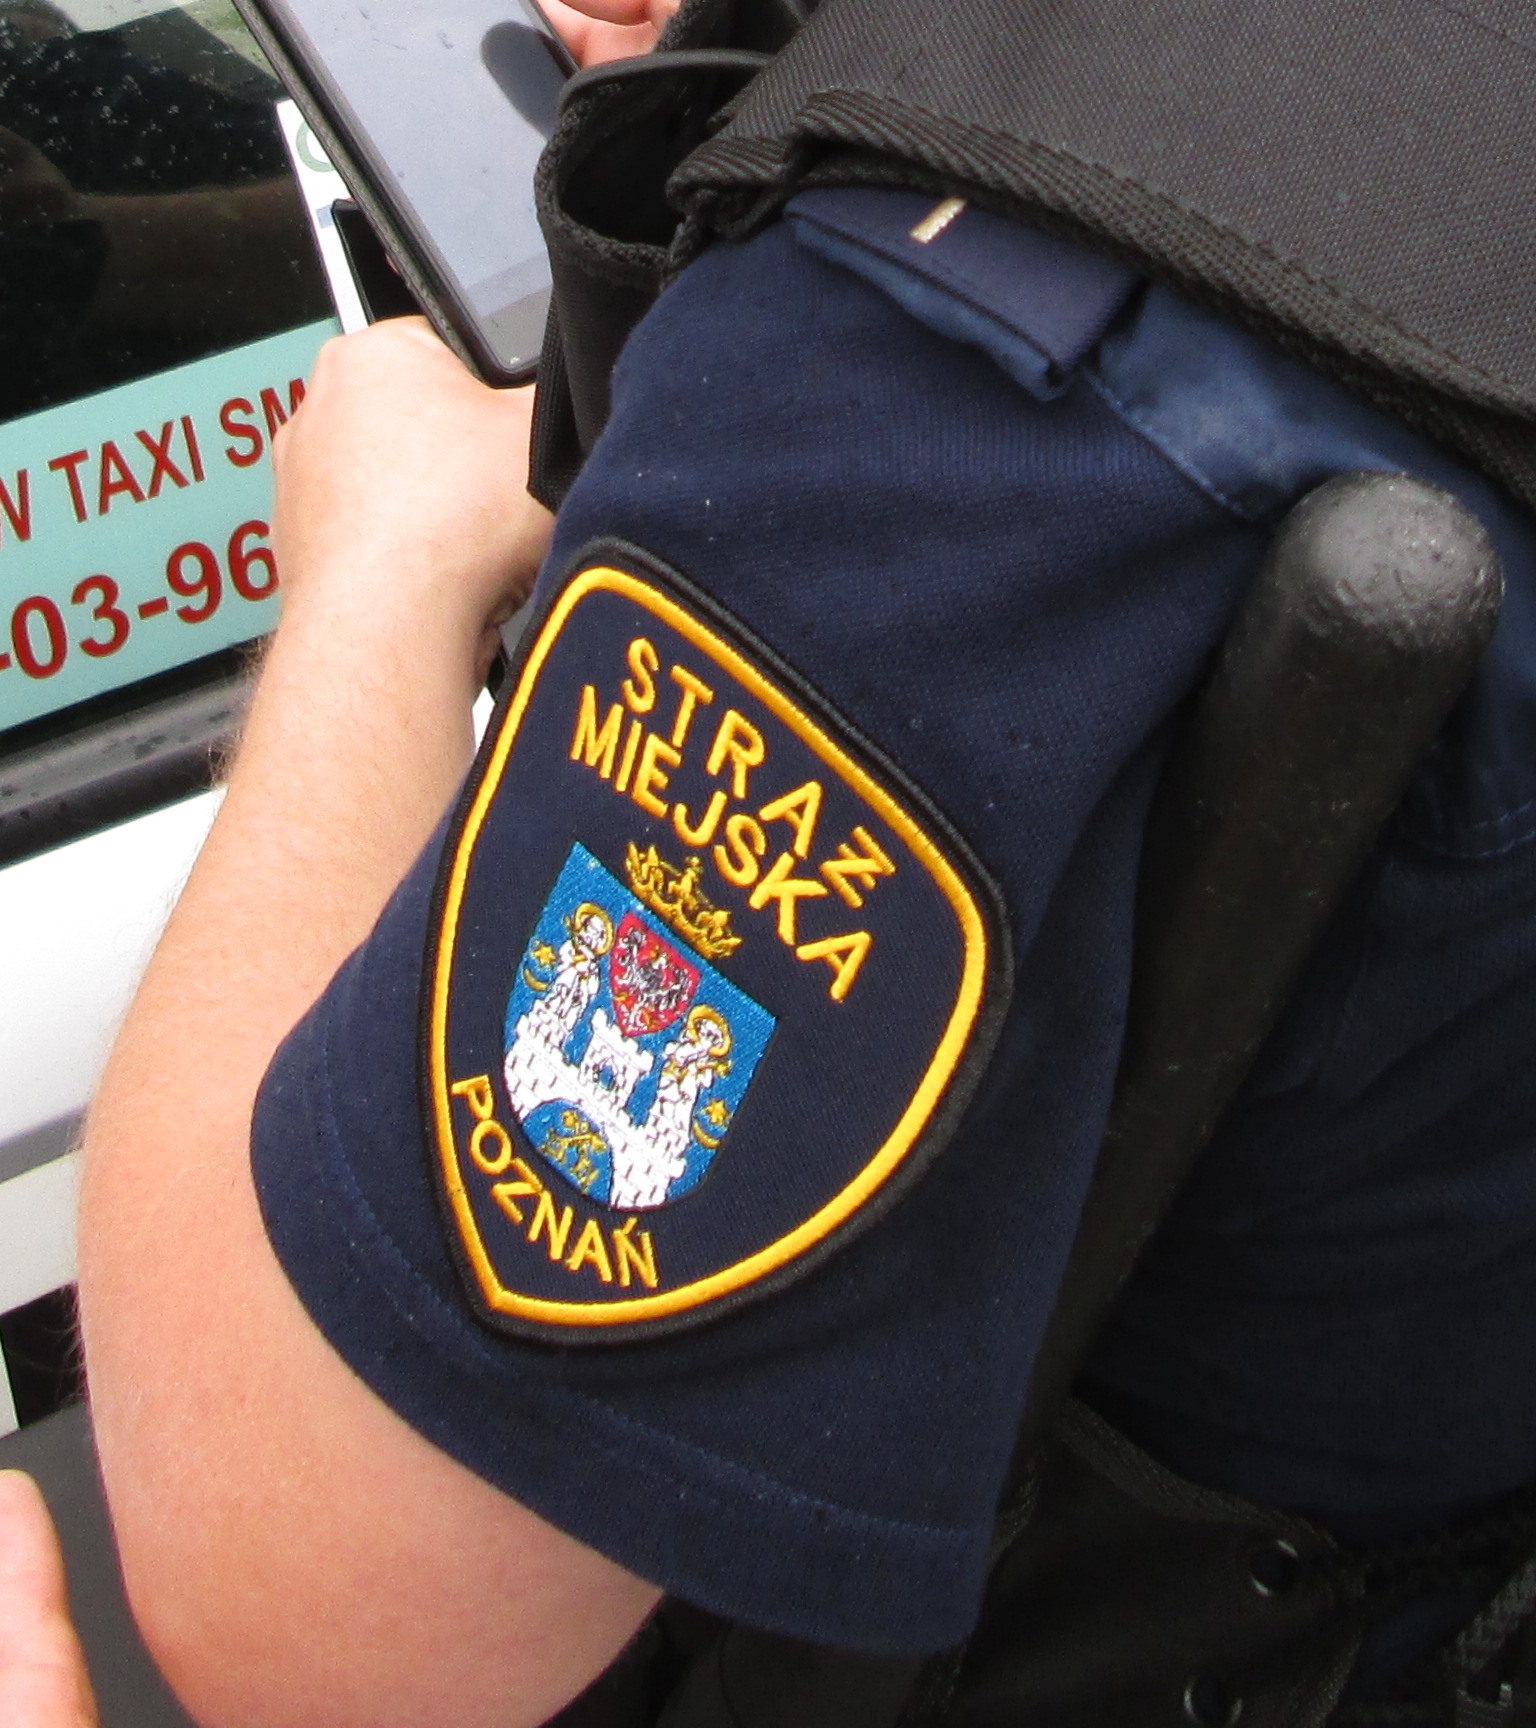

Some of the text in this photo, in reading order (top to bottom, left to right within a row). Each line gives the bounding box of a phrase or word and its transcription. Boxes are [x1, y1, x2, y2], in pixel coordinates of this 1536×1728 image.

[47, 414, 206, 524] TAXI
[219, 378, 307, 468] SM
[568, 684, 875, 1003] MIEJSKA
[451, 1073, 658, 1290] POZNAŃ
